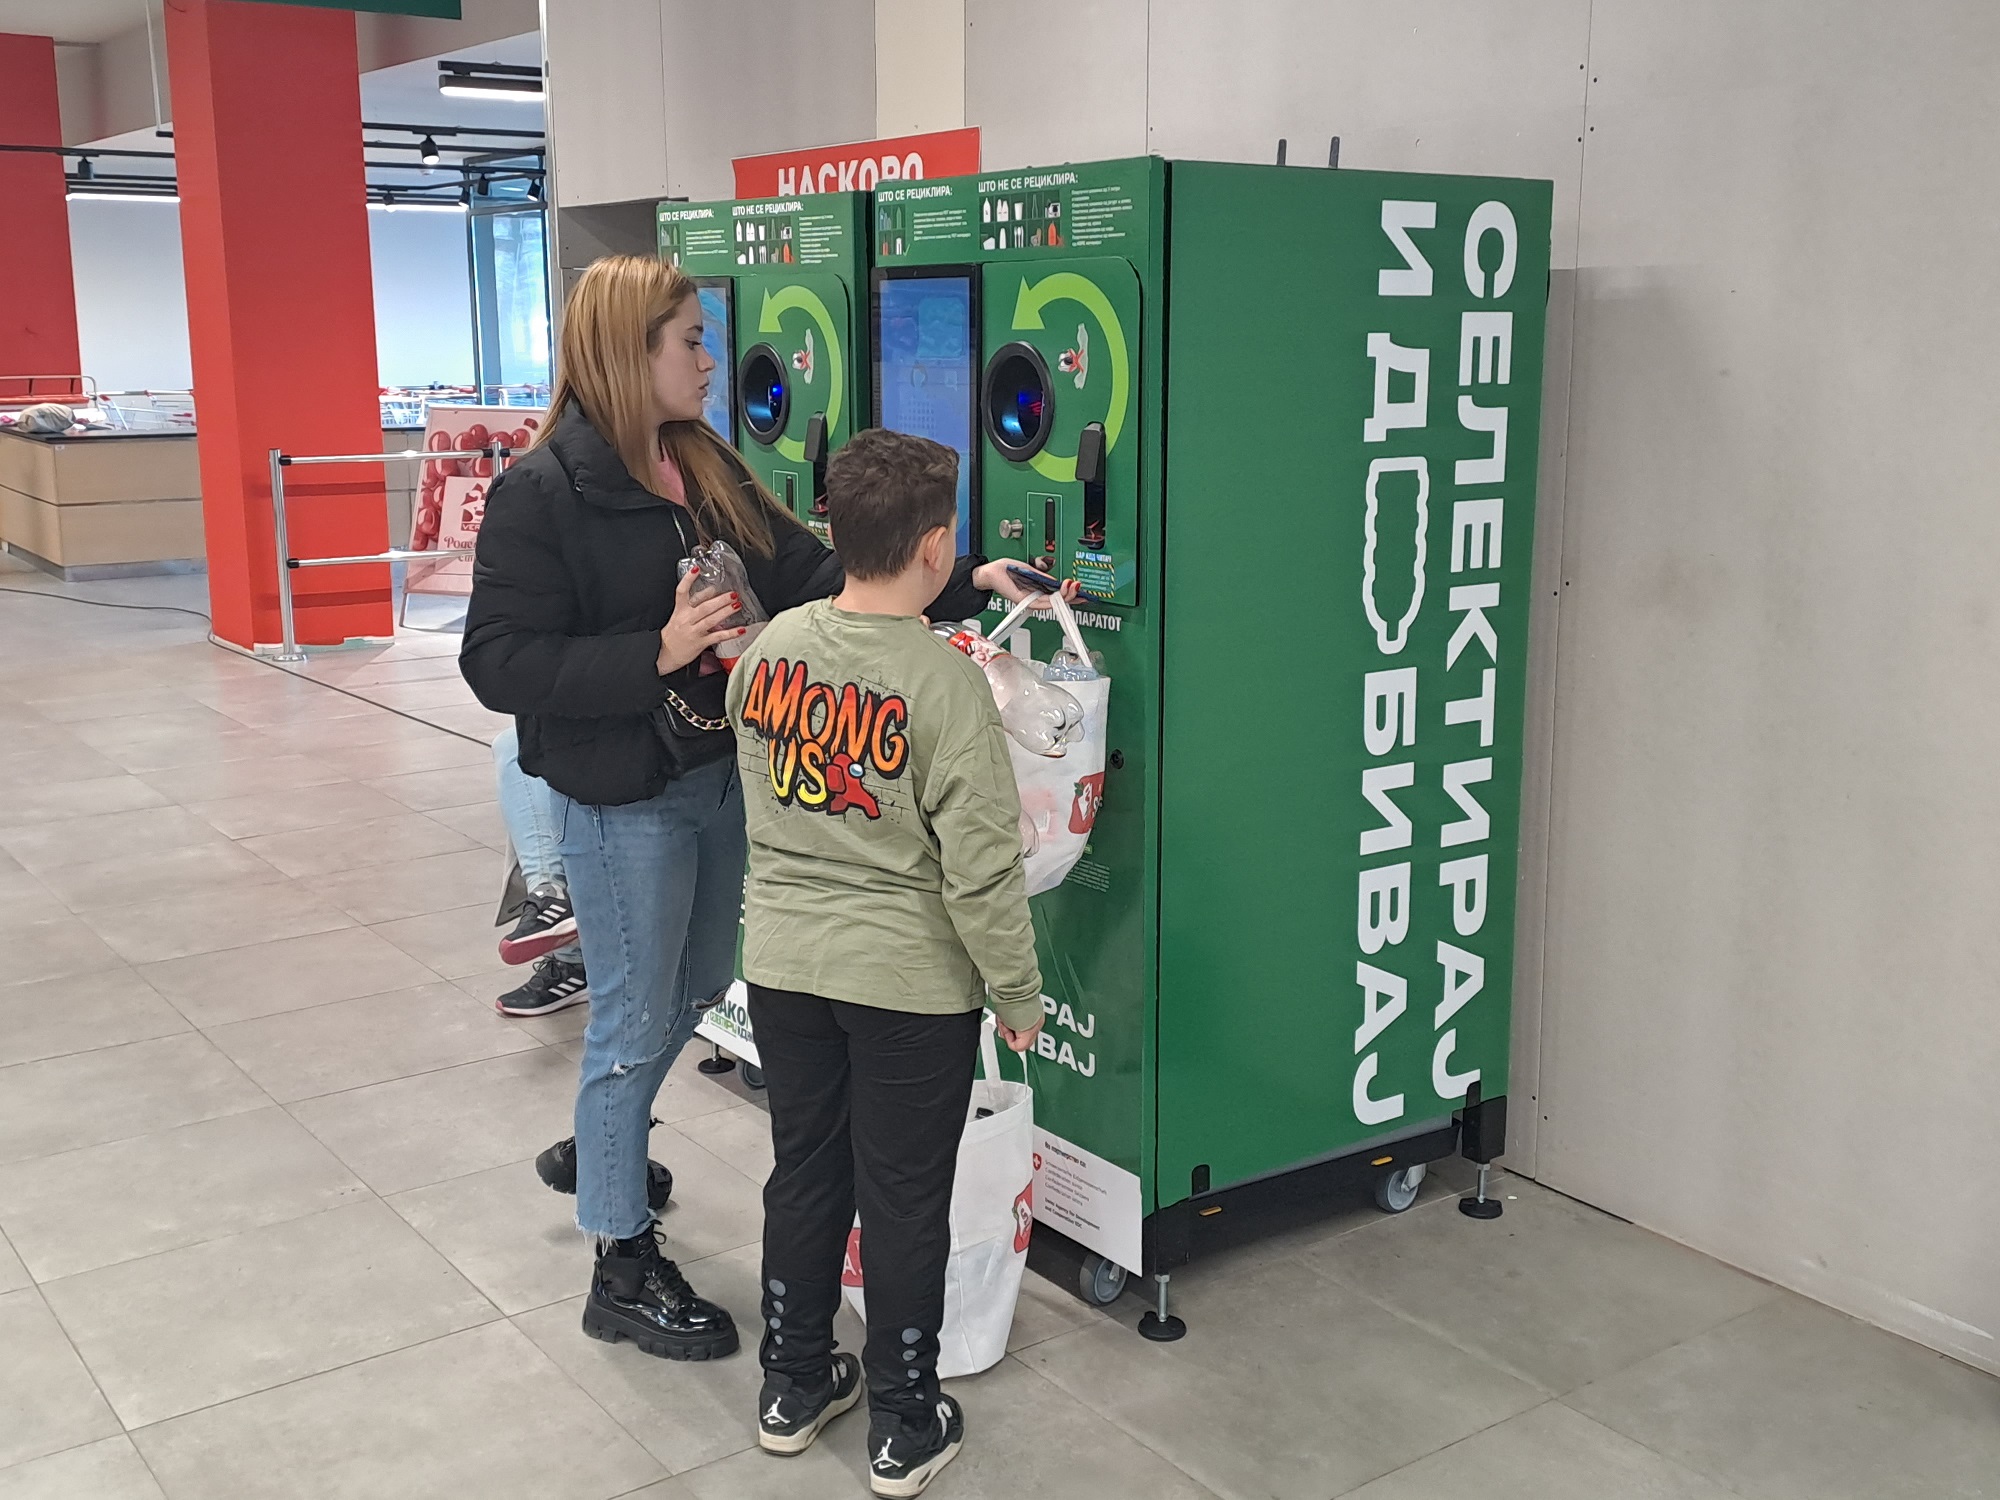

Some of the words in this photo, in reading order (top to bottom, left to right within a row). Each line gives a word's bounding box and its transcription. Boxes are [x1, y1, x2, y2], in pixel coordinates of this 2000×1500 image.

[732, 205, 745, 217] ШТО
[746, 204, 755, 215] НЕ
[755, 203, 765, 215] СЕ
[877, 190, 894, 203] ШТО
[895, 189, 906, 201] СЕ
[978, 180, 996, 193] ШТО
[997, 178, 1010, 191] НЕ
[1010, 177, 1022, 190] СЕ
[1377, 199, 1437, 297] И
[1432, 200, 1519, 1100] СЕЛЕКТИРАЈ
[741, 657, 910, 780] AMONG
[767, 735, 829, 812] US
